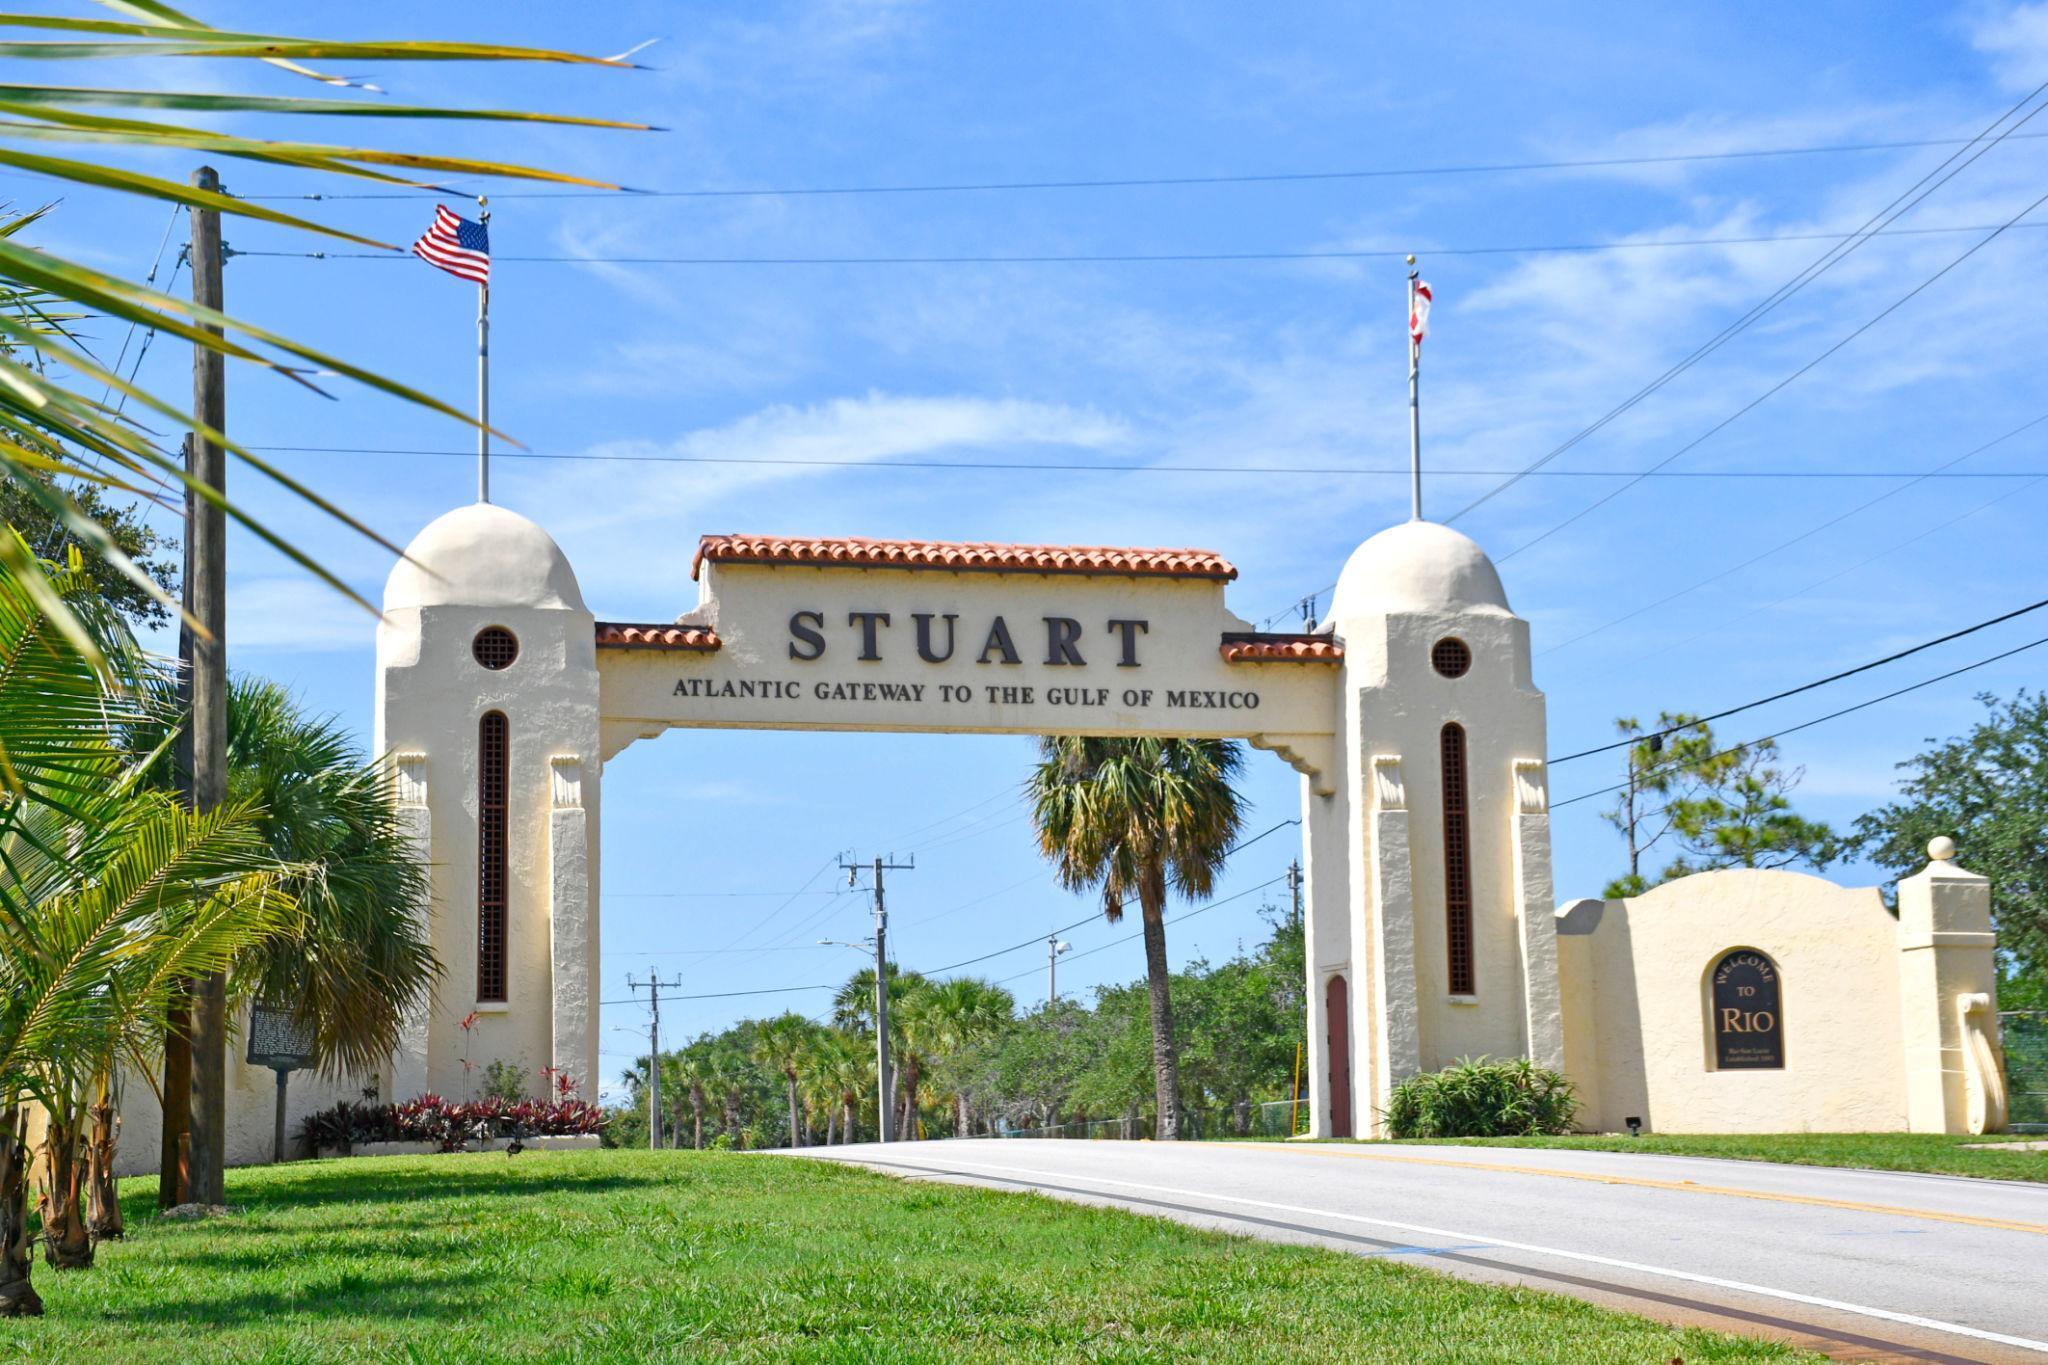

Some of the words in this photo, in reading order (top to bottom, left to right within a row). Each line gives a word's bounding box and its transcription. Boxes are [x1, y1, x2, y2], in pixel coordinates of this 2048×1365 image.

[788, 610, 1149, 669] STUART
[672, 678, 800, 700] ATLANTIC
[814, 682, 925, 702] GATEWAY
[938, 684, 972, 703] TO
[985, 685, 1035, 705] THE
[1046, 687, 1110, 706] GULF
[1122, 689, 1153, 707] OF
[1166, 690, 1260, 710] MEXICO
[1716, 954, 1774, 984] WELCOME
[1736, 985, 1755, 997] TO
[1720, 1007, 1775, 1033] RIO
